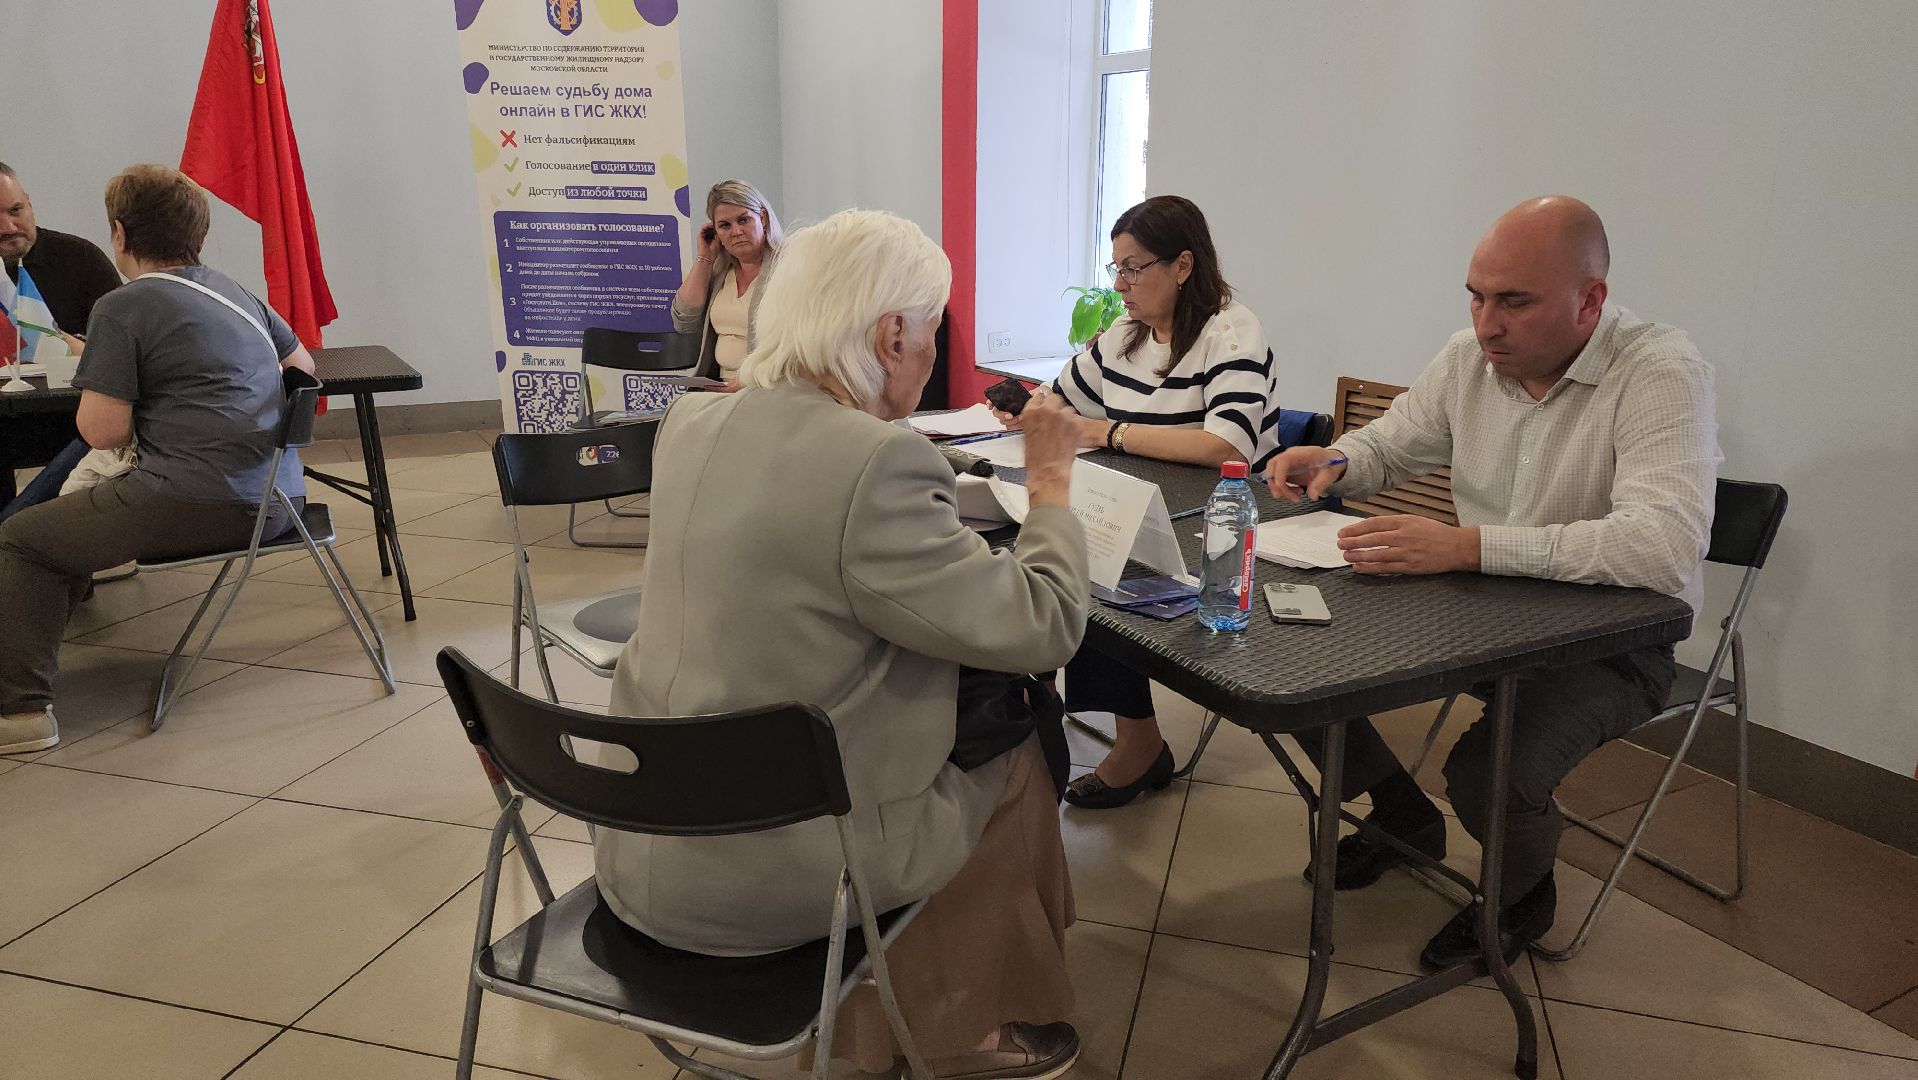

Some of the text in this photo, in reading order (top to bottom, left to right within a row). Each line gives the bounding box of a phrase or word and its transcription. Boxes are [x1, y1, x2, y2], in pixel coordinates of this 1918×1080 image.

[490, 81, 652, 100] Решаем судьбу дома
[499, 104, 647, 119] онлайн в ГИС ЖКХ!
[523, 134, 636, 147] Нет фальсификациям
[525, 160, 590, 171] Голосование
[601, 164, 626, 173] один
[628, 164, 655, 173] клик
[528, 186, 646, 198] Доступ из любой точки
[509, 220, 664, 234] Как организовать голосование?
[503, 238, 510, 248] 1
[506, 263, 514, 273] 2
[509, 297, 516, 306] 3
[513, 330, 520, 339] 4
[533, 358, 565, 368] ГИС ЖКХ
